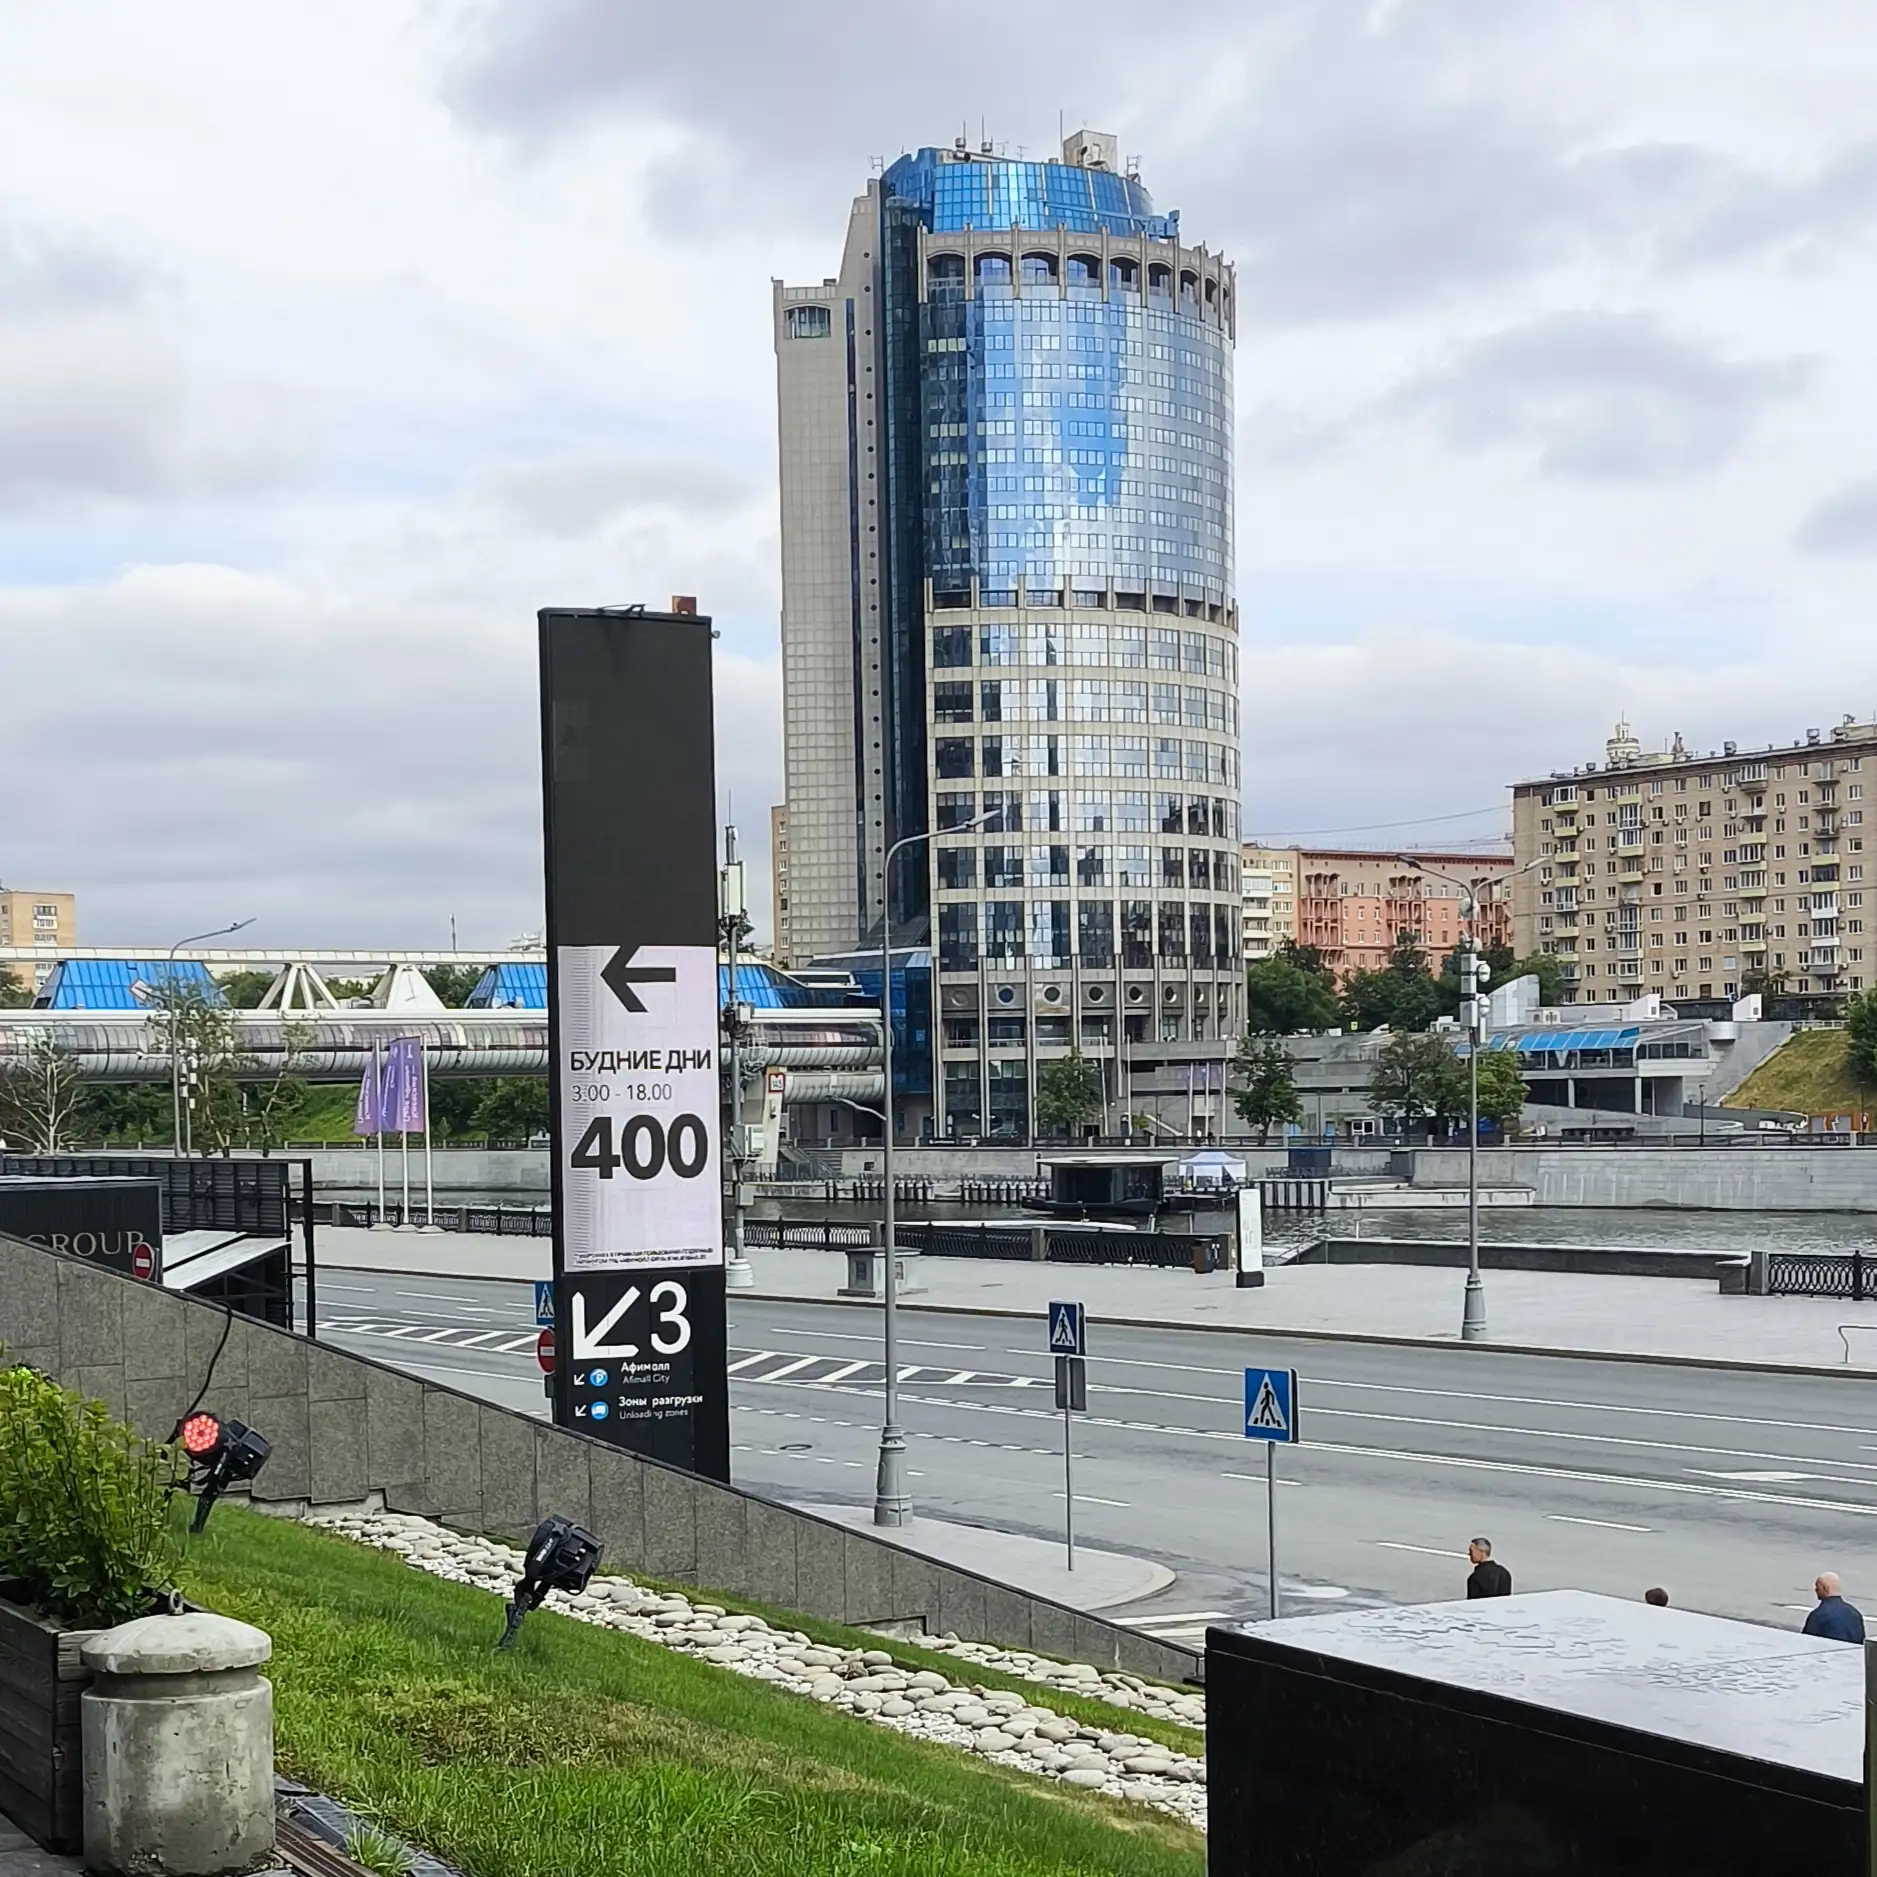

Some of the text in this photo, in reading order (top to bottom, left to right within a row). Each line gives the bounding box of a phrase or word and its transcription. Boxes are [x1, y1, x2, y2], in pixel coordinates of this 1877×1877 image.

[571, 1049, 711, 1074] БУДНИЕ ДНИ
[626, 1083, 672, 1101] 18.00
[571, 1113, 708, 1180] 400
[649, 1280, 691, 1355] 3
[621, 1362, 670, 1375] Афимолл
[622, 1373, 671, 1385] Afimall City
[618, 1394, 703, 1409] Зоны разгрузки
[619, 1408, 689, 1420] Unloading zones
